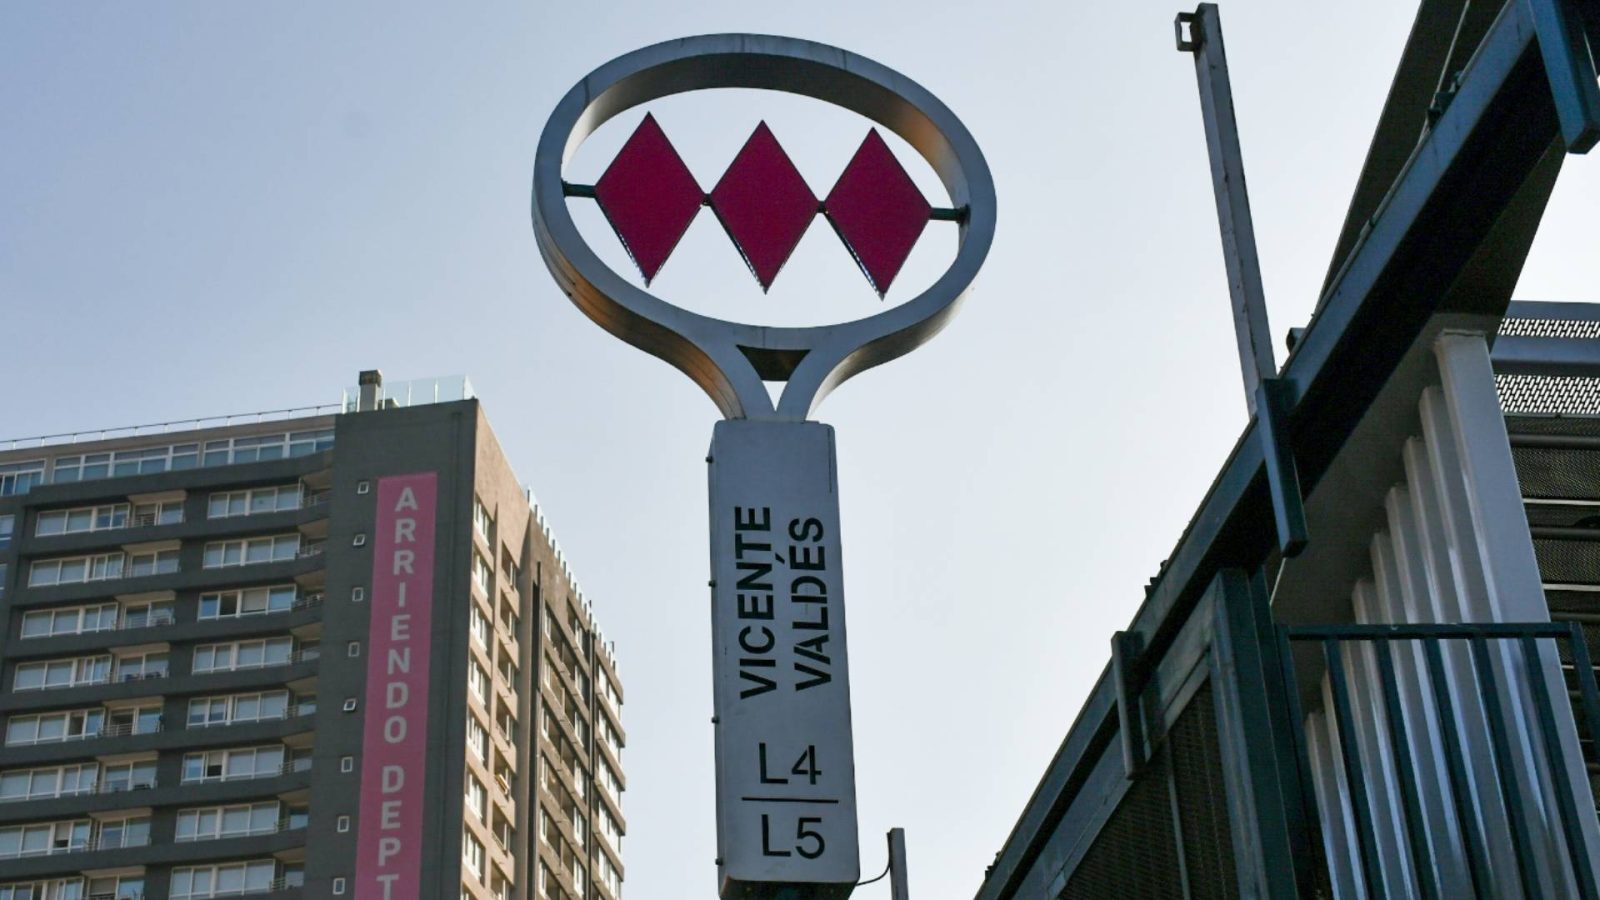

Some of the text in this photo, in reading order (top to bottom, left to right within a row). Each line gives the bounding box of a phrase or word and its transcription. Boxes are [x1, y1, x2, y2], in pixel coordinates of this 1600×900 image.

[734, 506, 778, 700] VICENTE
[775, 517, 832, 691] VALDÉS
[376, 486, 418, 900] ARRIENDO DEPT
[759, 742, 822, 785] L4
[761, 814, 825, 859] L5
